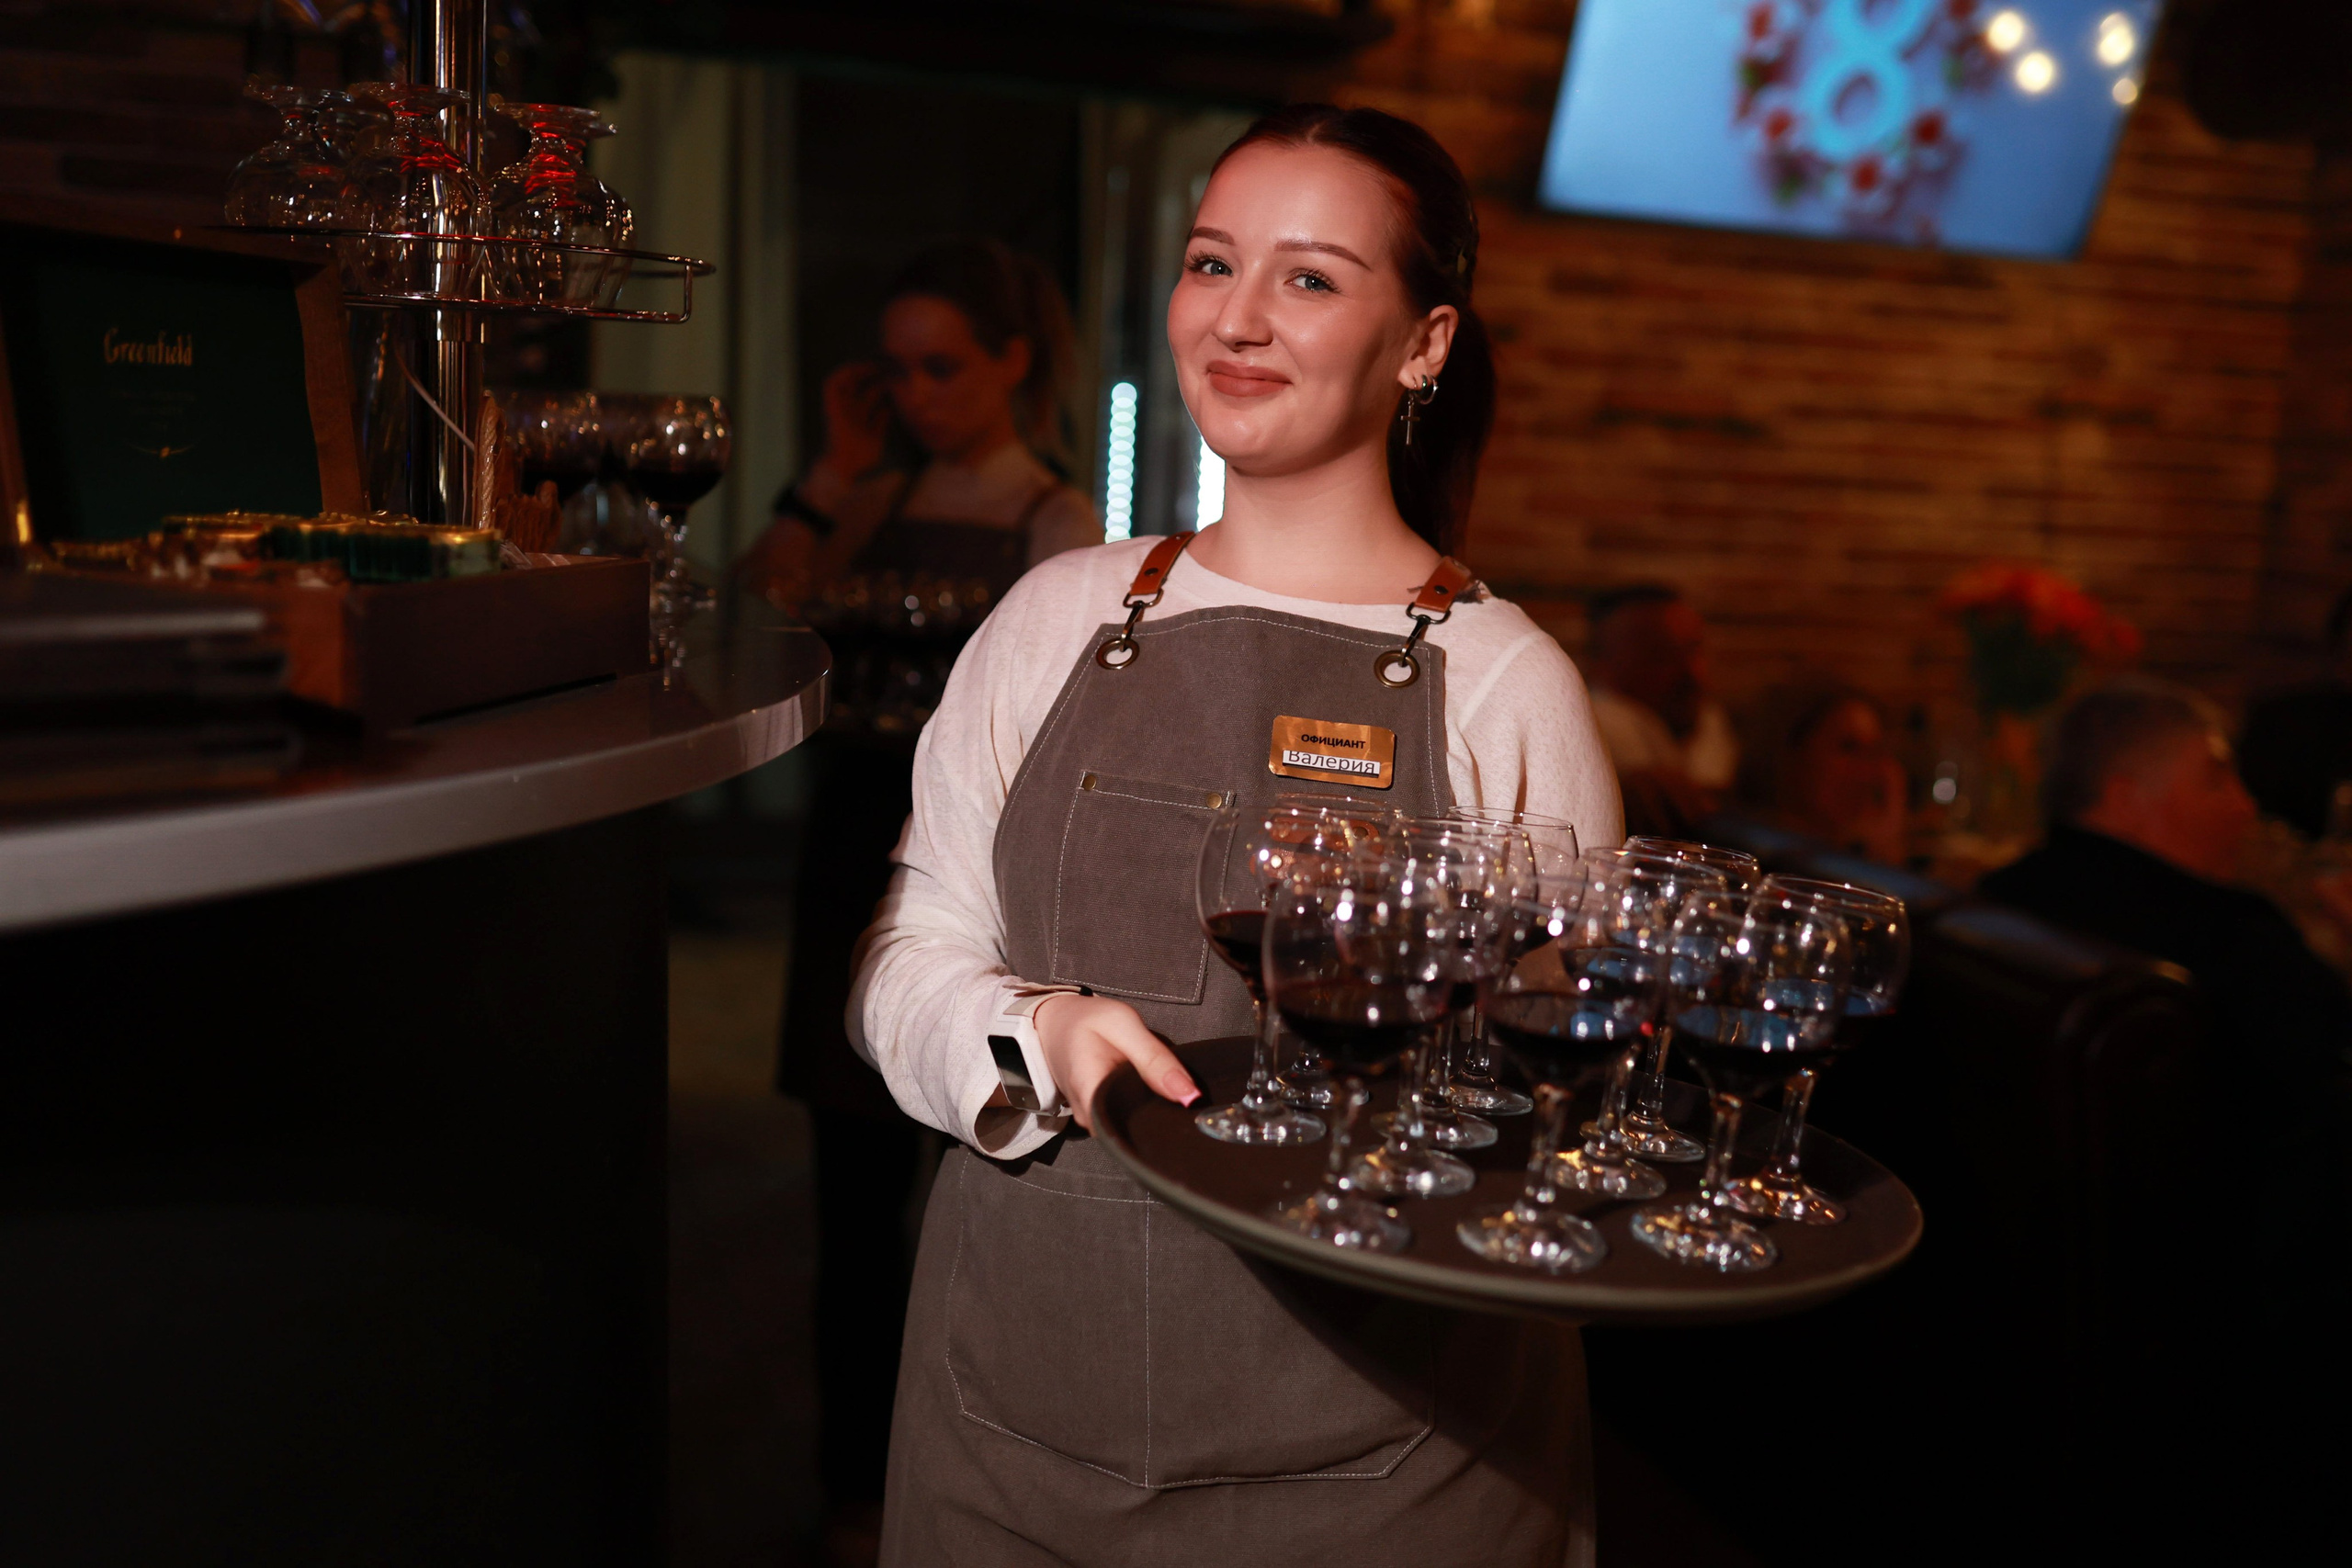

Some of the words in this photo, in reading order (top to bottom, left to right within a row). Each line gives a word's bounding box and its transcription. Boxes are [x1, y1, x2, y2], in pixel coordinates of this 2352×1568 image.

[1801, 0, 1928, 162] 8
[103, 327, 193, 366] Greenfield
[1301, 734, 1366, 749] ОФИЦИАНТ
[1288, 750, 1375, 773] Валерия
